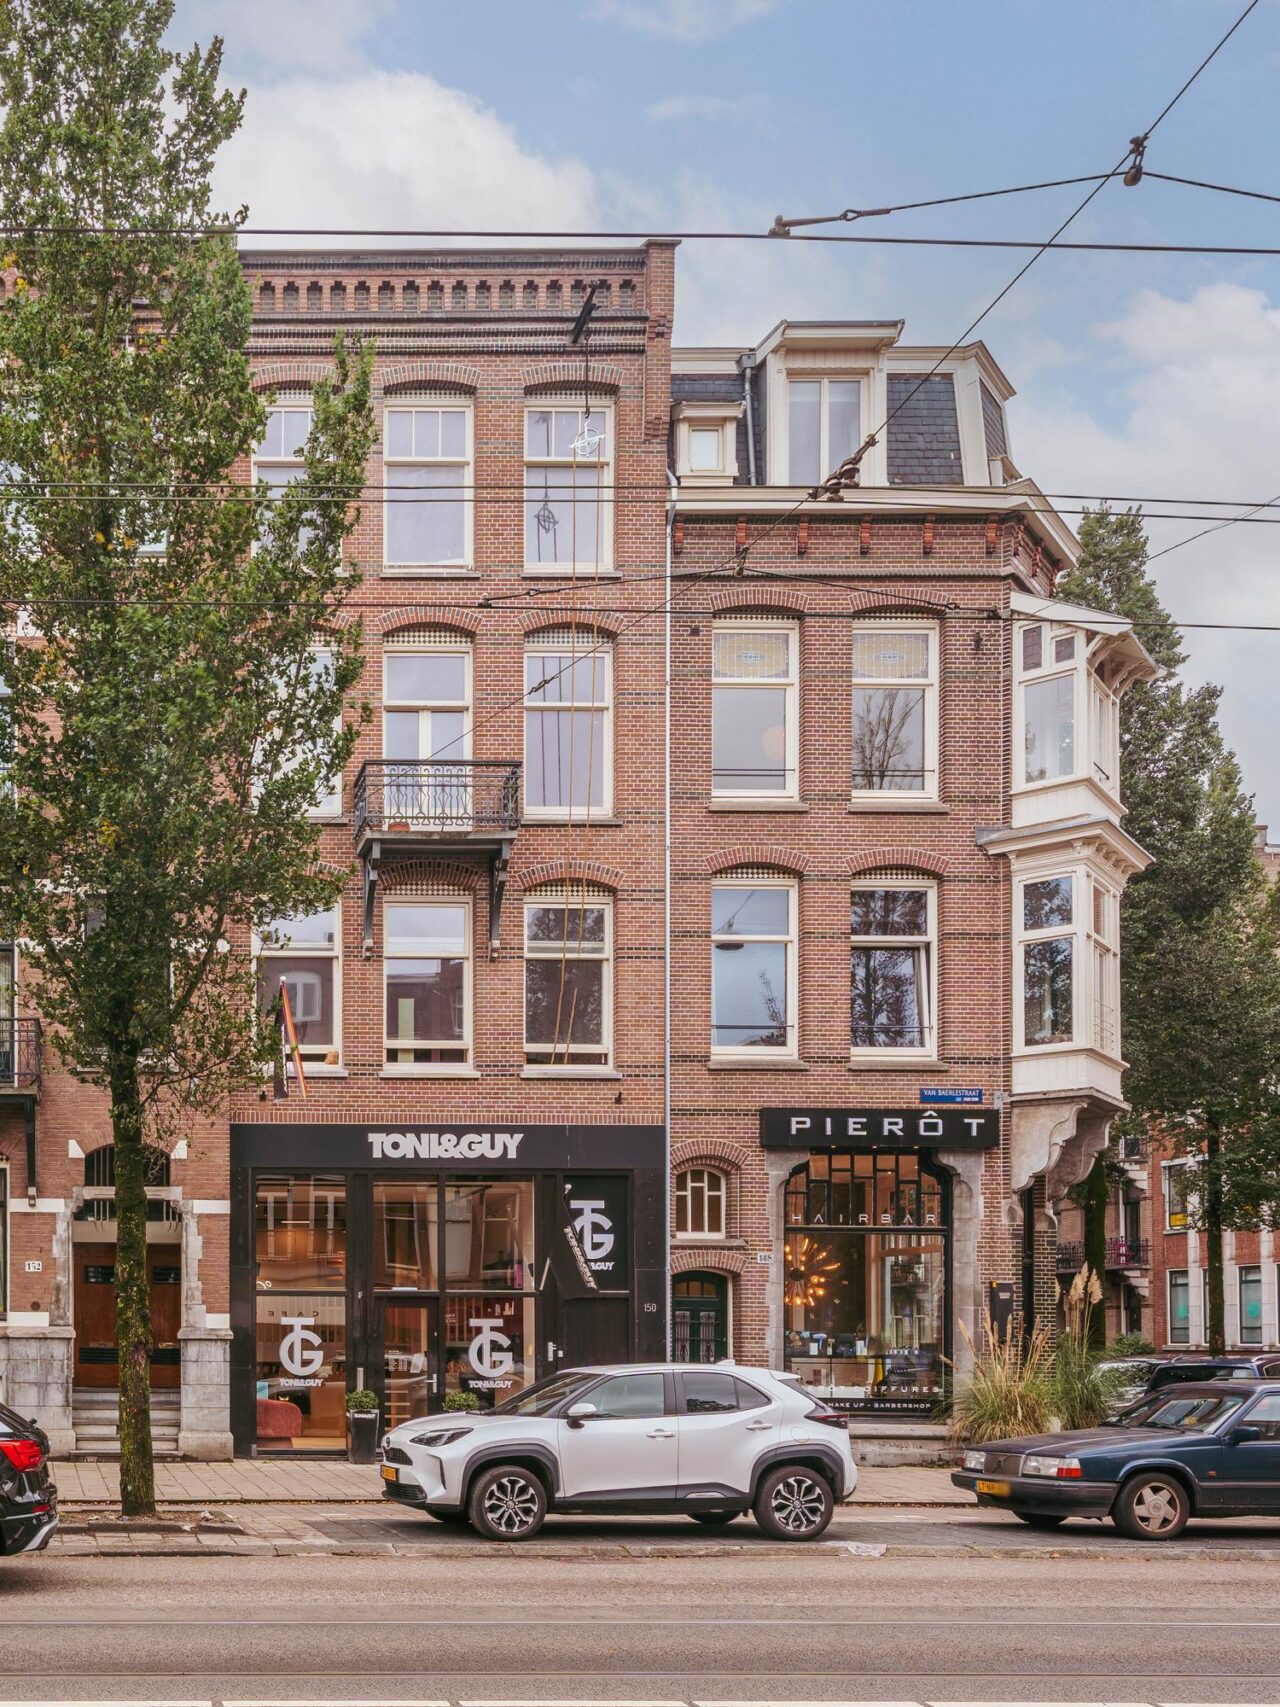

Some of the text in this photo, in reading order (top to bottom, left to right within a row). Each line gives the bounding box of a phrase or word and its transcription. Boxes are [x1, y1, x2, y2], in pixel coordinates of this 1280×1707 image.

[938, 1089, 980, 1097] BAERLESTRAAT
[790, 1110, 985, 1137] PIERÔT
[368, 1133, 524, 1159] TONI&GUY
[791, 1213, 936, 1224] HAIRBAR
[27, 1262, 41, 1271] 152
[643, 1304, 657, 1312] 150
[280, 1378, 323, 1387] TONI&GUY
[468, 1380, 513, 1389] TONI&GUY
